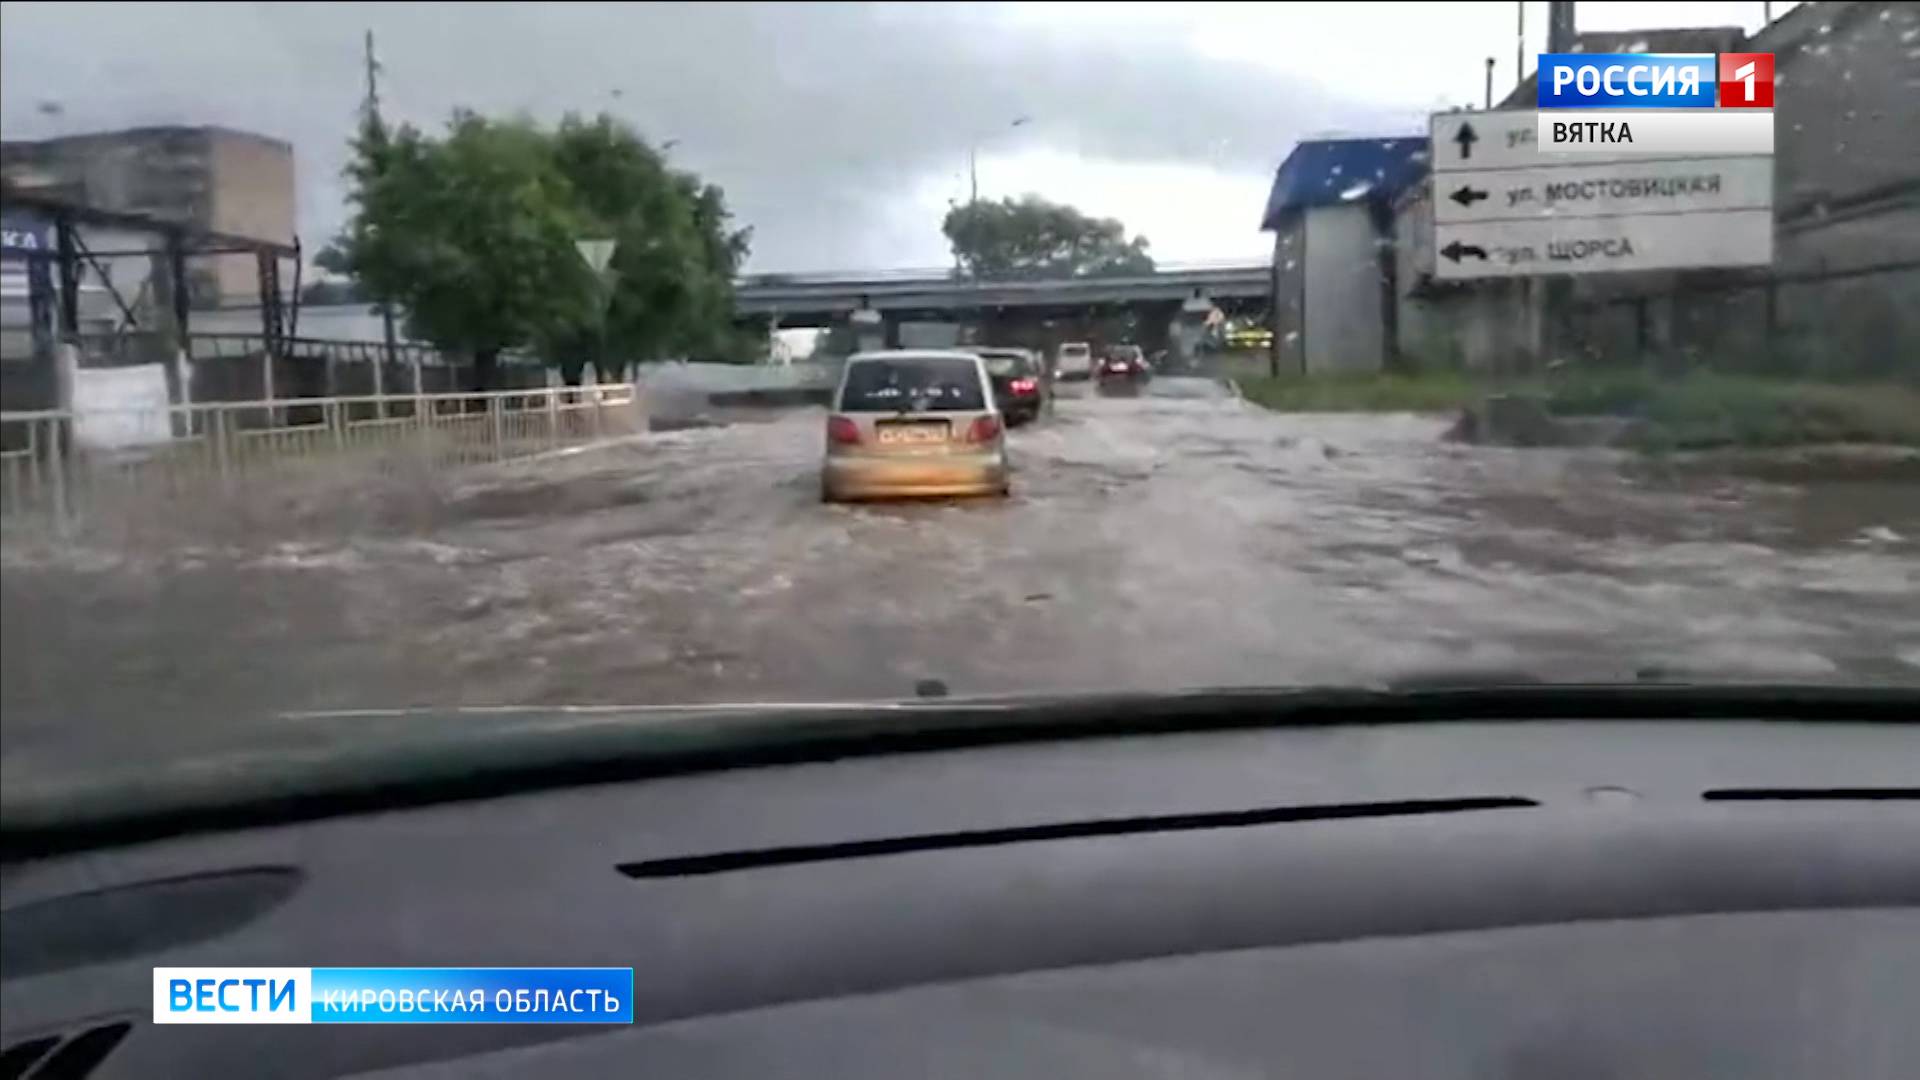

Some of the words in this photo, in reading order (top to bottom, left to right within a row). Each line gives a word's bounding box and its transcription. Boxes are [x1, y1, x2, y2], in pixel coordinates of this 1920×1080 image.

[1507, 188, 1535, 205] ул.
[1546, 175, 1721, 201] МОСТОВИЦКАЯ
[1548, 238, 1635, 262] ЩОРСА
